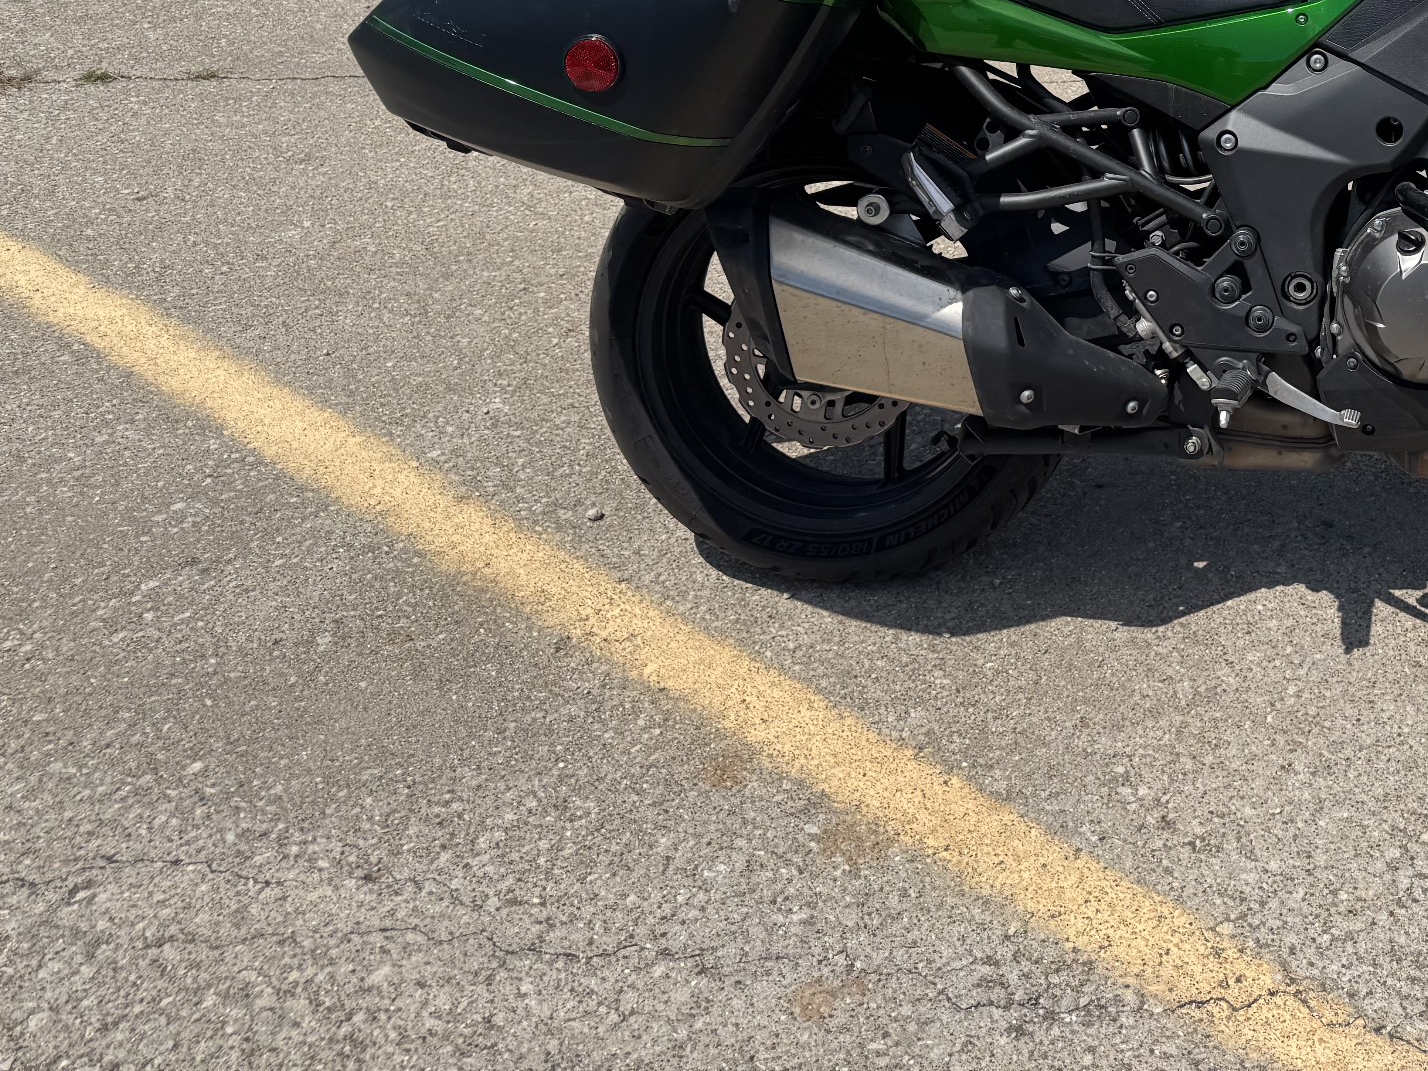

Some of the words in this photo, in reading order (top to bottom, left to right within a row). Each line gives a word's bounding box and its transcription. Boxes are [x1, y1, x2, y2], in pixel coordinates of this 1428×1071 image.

[884, 488, 971, 548] MICHELIN
[752, 532, 772, 546] 17
[777, 537, 802, 554] ZR
